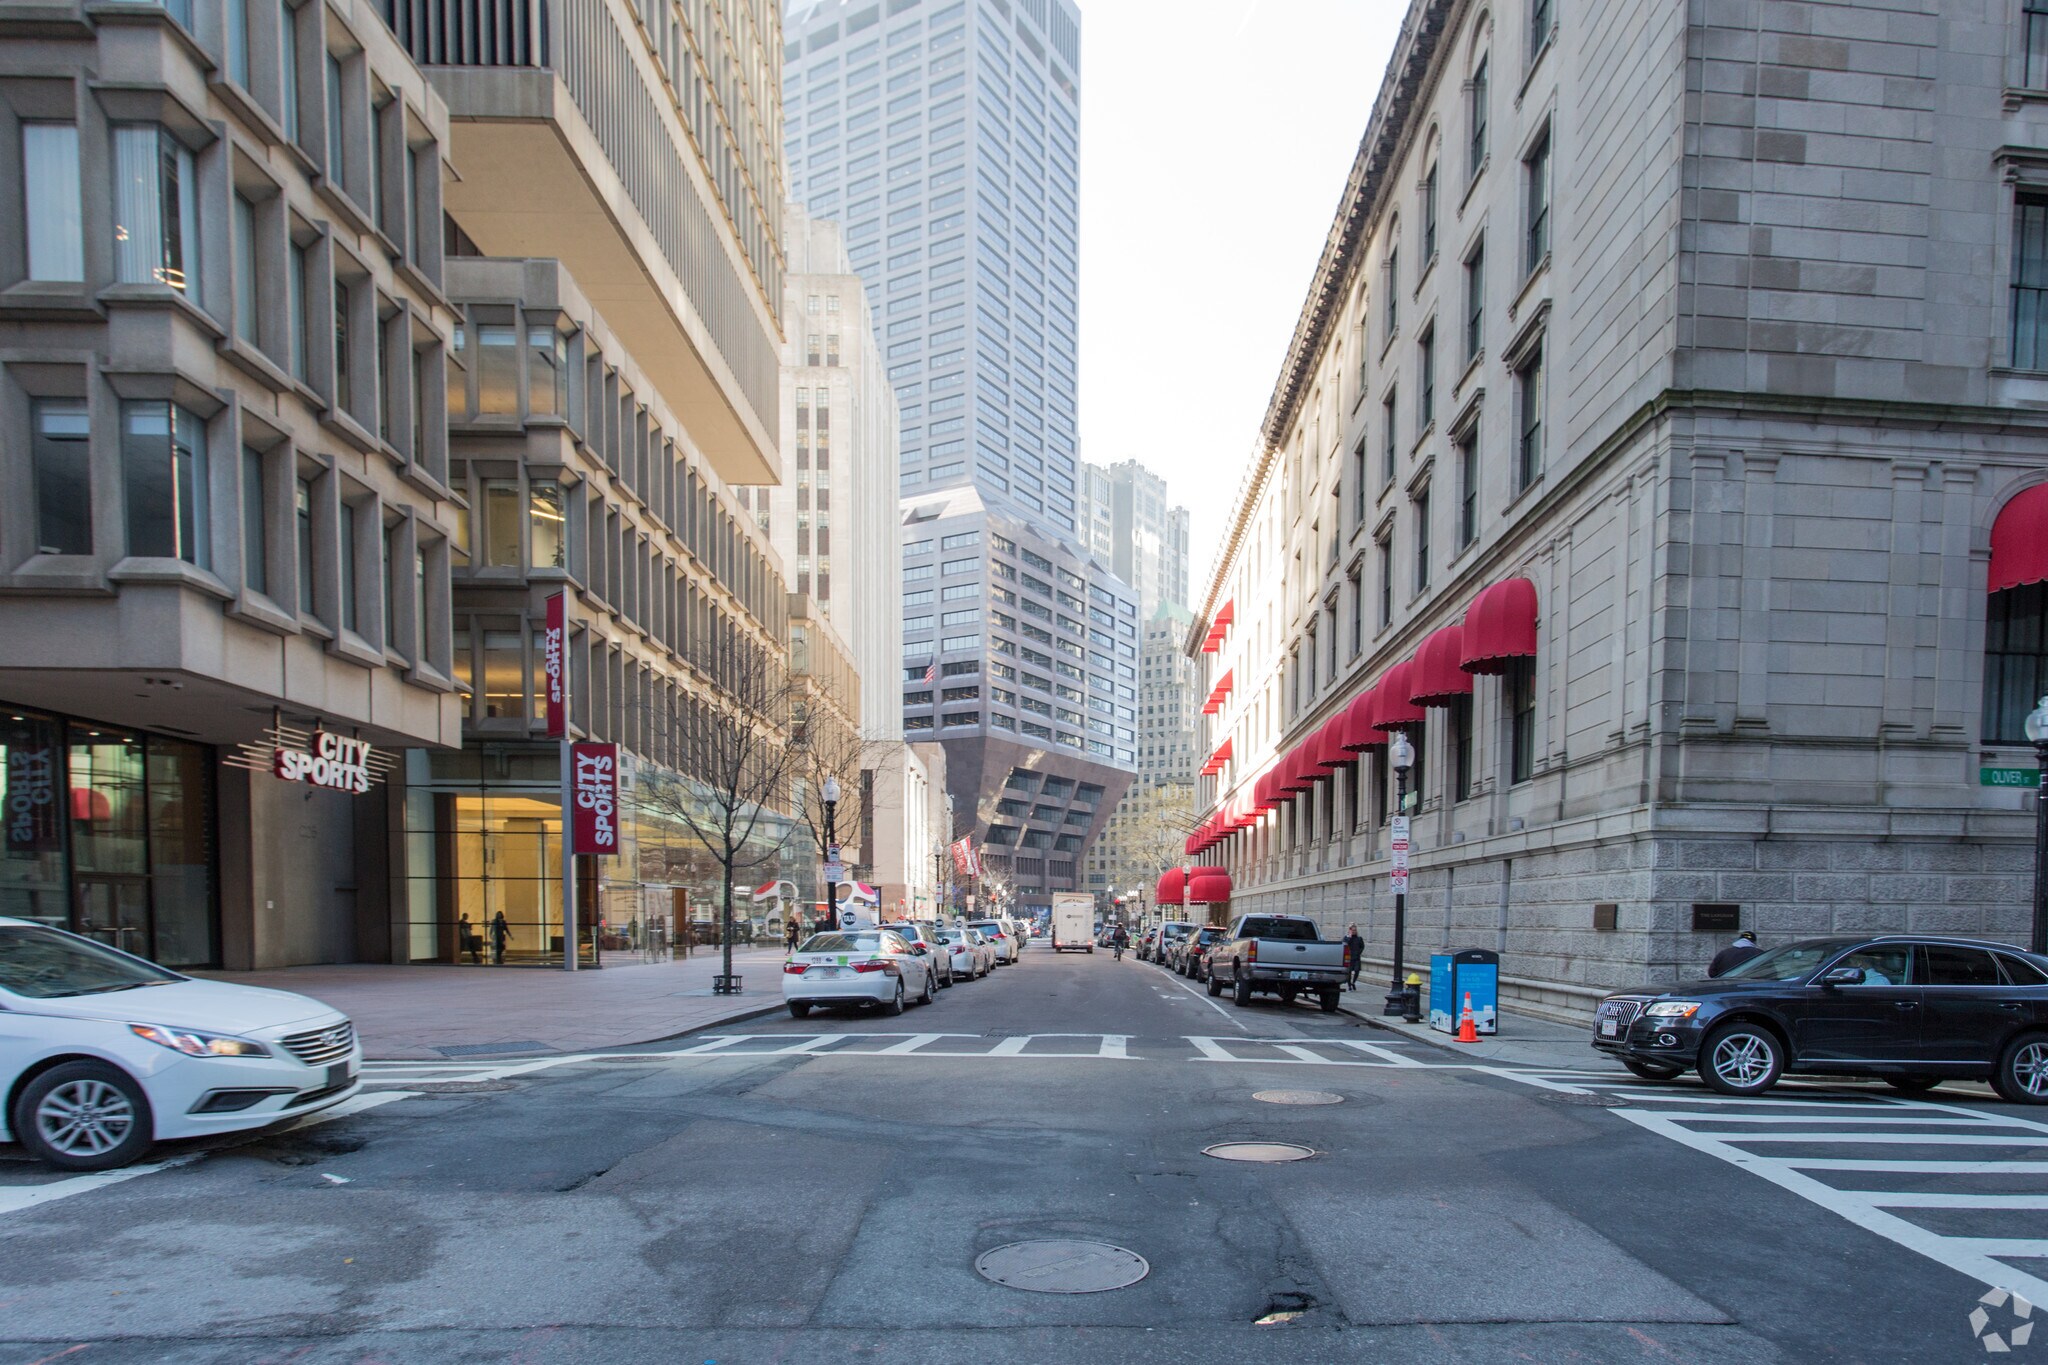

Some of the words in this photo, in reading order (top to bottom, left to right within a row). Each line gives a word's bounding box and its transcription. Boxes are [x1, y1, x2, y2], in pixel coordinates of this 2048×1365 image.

[546, 628, 554, 674] CITY
[551, 627, 561, 703] SPORTS
[281, 749, 370, 793] SPORTS
[319, 732, 371, 767] CITY
[577, 752, 596, 808] CITY
[1992, 770, 2022, 784] OLIVER
[594, 755, 614, 846] SPORTS
